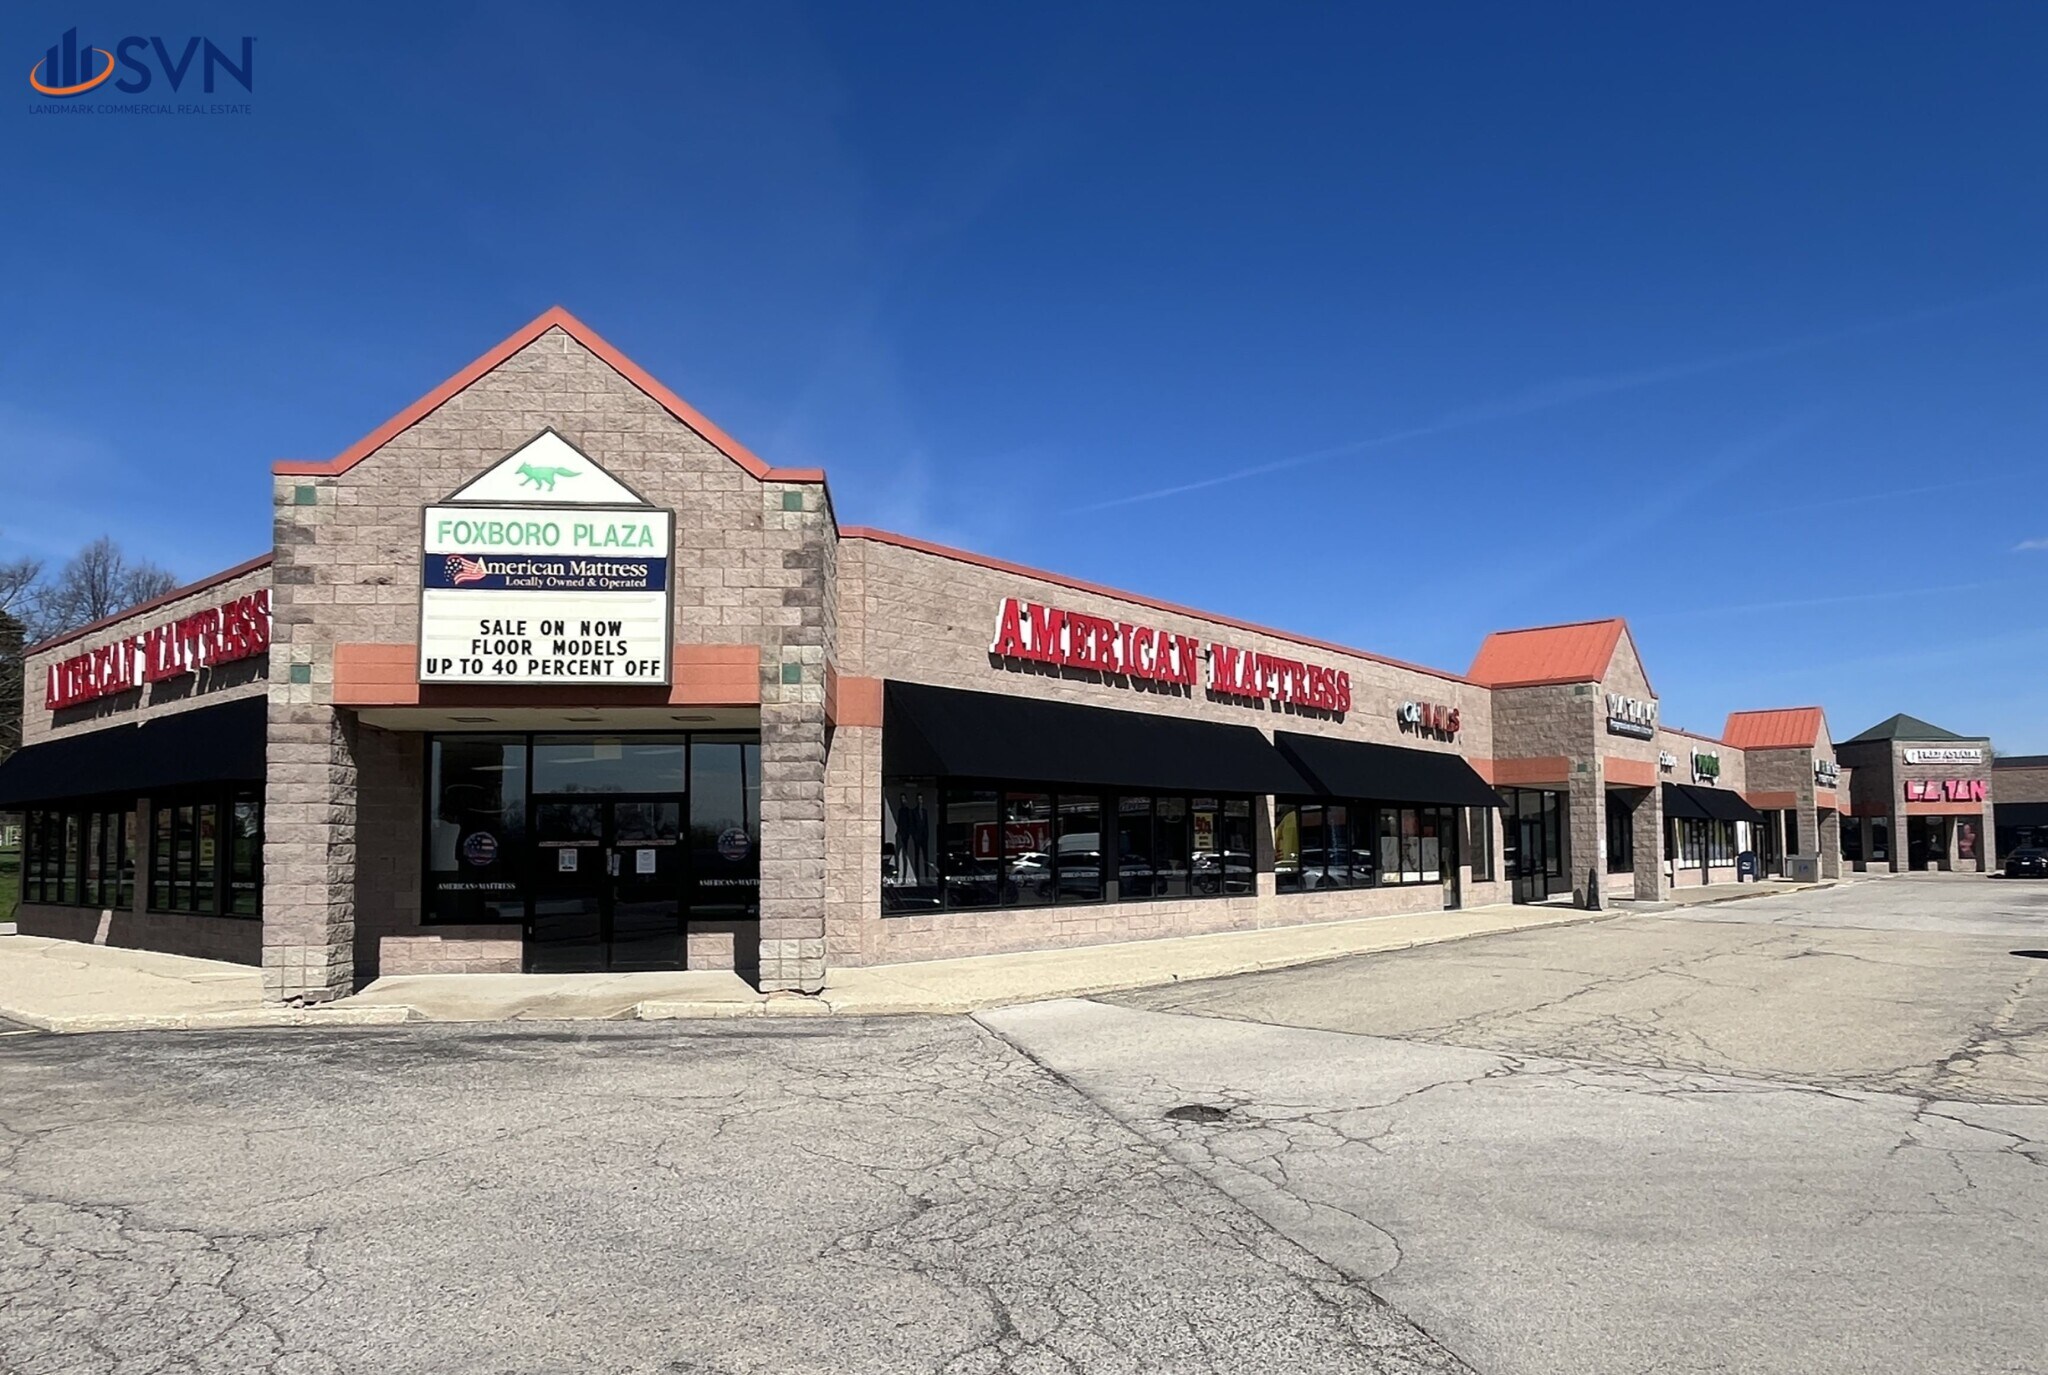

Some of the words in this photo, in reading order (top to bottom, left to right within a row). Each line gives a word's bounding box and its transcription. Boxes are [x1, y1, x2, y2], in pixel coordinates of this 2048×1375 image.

[437, 520, 560, 546] FOXBORO
[573, 524, 655, 548] PLAZA
[472, 556, 565, 576] American
[569, 560, 648, 577] Mattress
[505, 576, 544, 588] Locally
[546, 576, 584, 587] Owned
[587, 578, 597, 587] &
[599, 577, 647, 590] Operated
[480, 619, 527, 636] SALE
[540, 620, 565, 636] ON
[580, 620, 622, 637] NOW
[471, 639, 533, 655] FLOOR
[552, 639, 628, 656] MODELS
[990, 598, 1199, 687] AMERICAN
[1206, 643, 1353, 713] MATTRESS
[426, 658, 453, 675] UP
[459, 658, 484, 675] TO
[492, 658, 518, 675] 40
[528, 659, 614, 676] PERCENT
[624, 660, 661, 676] OFF
